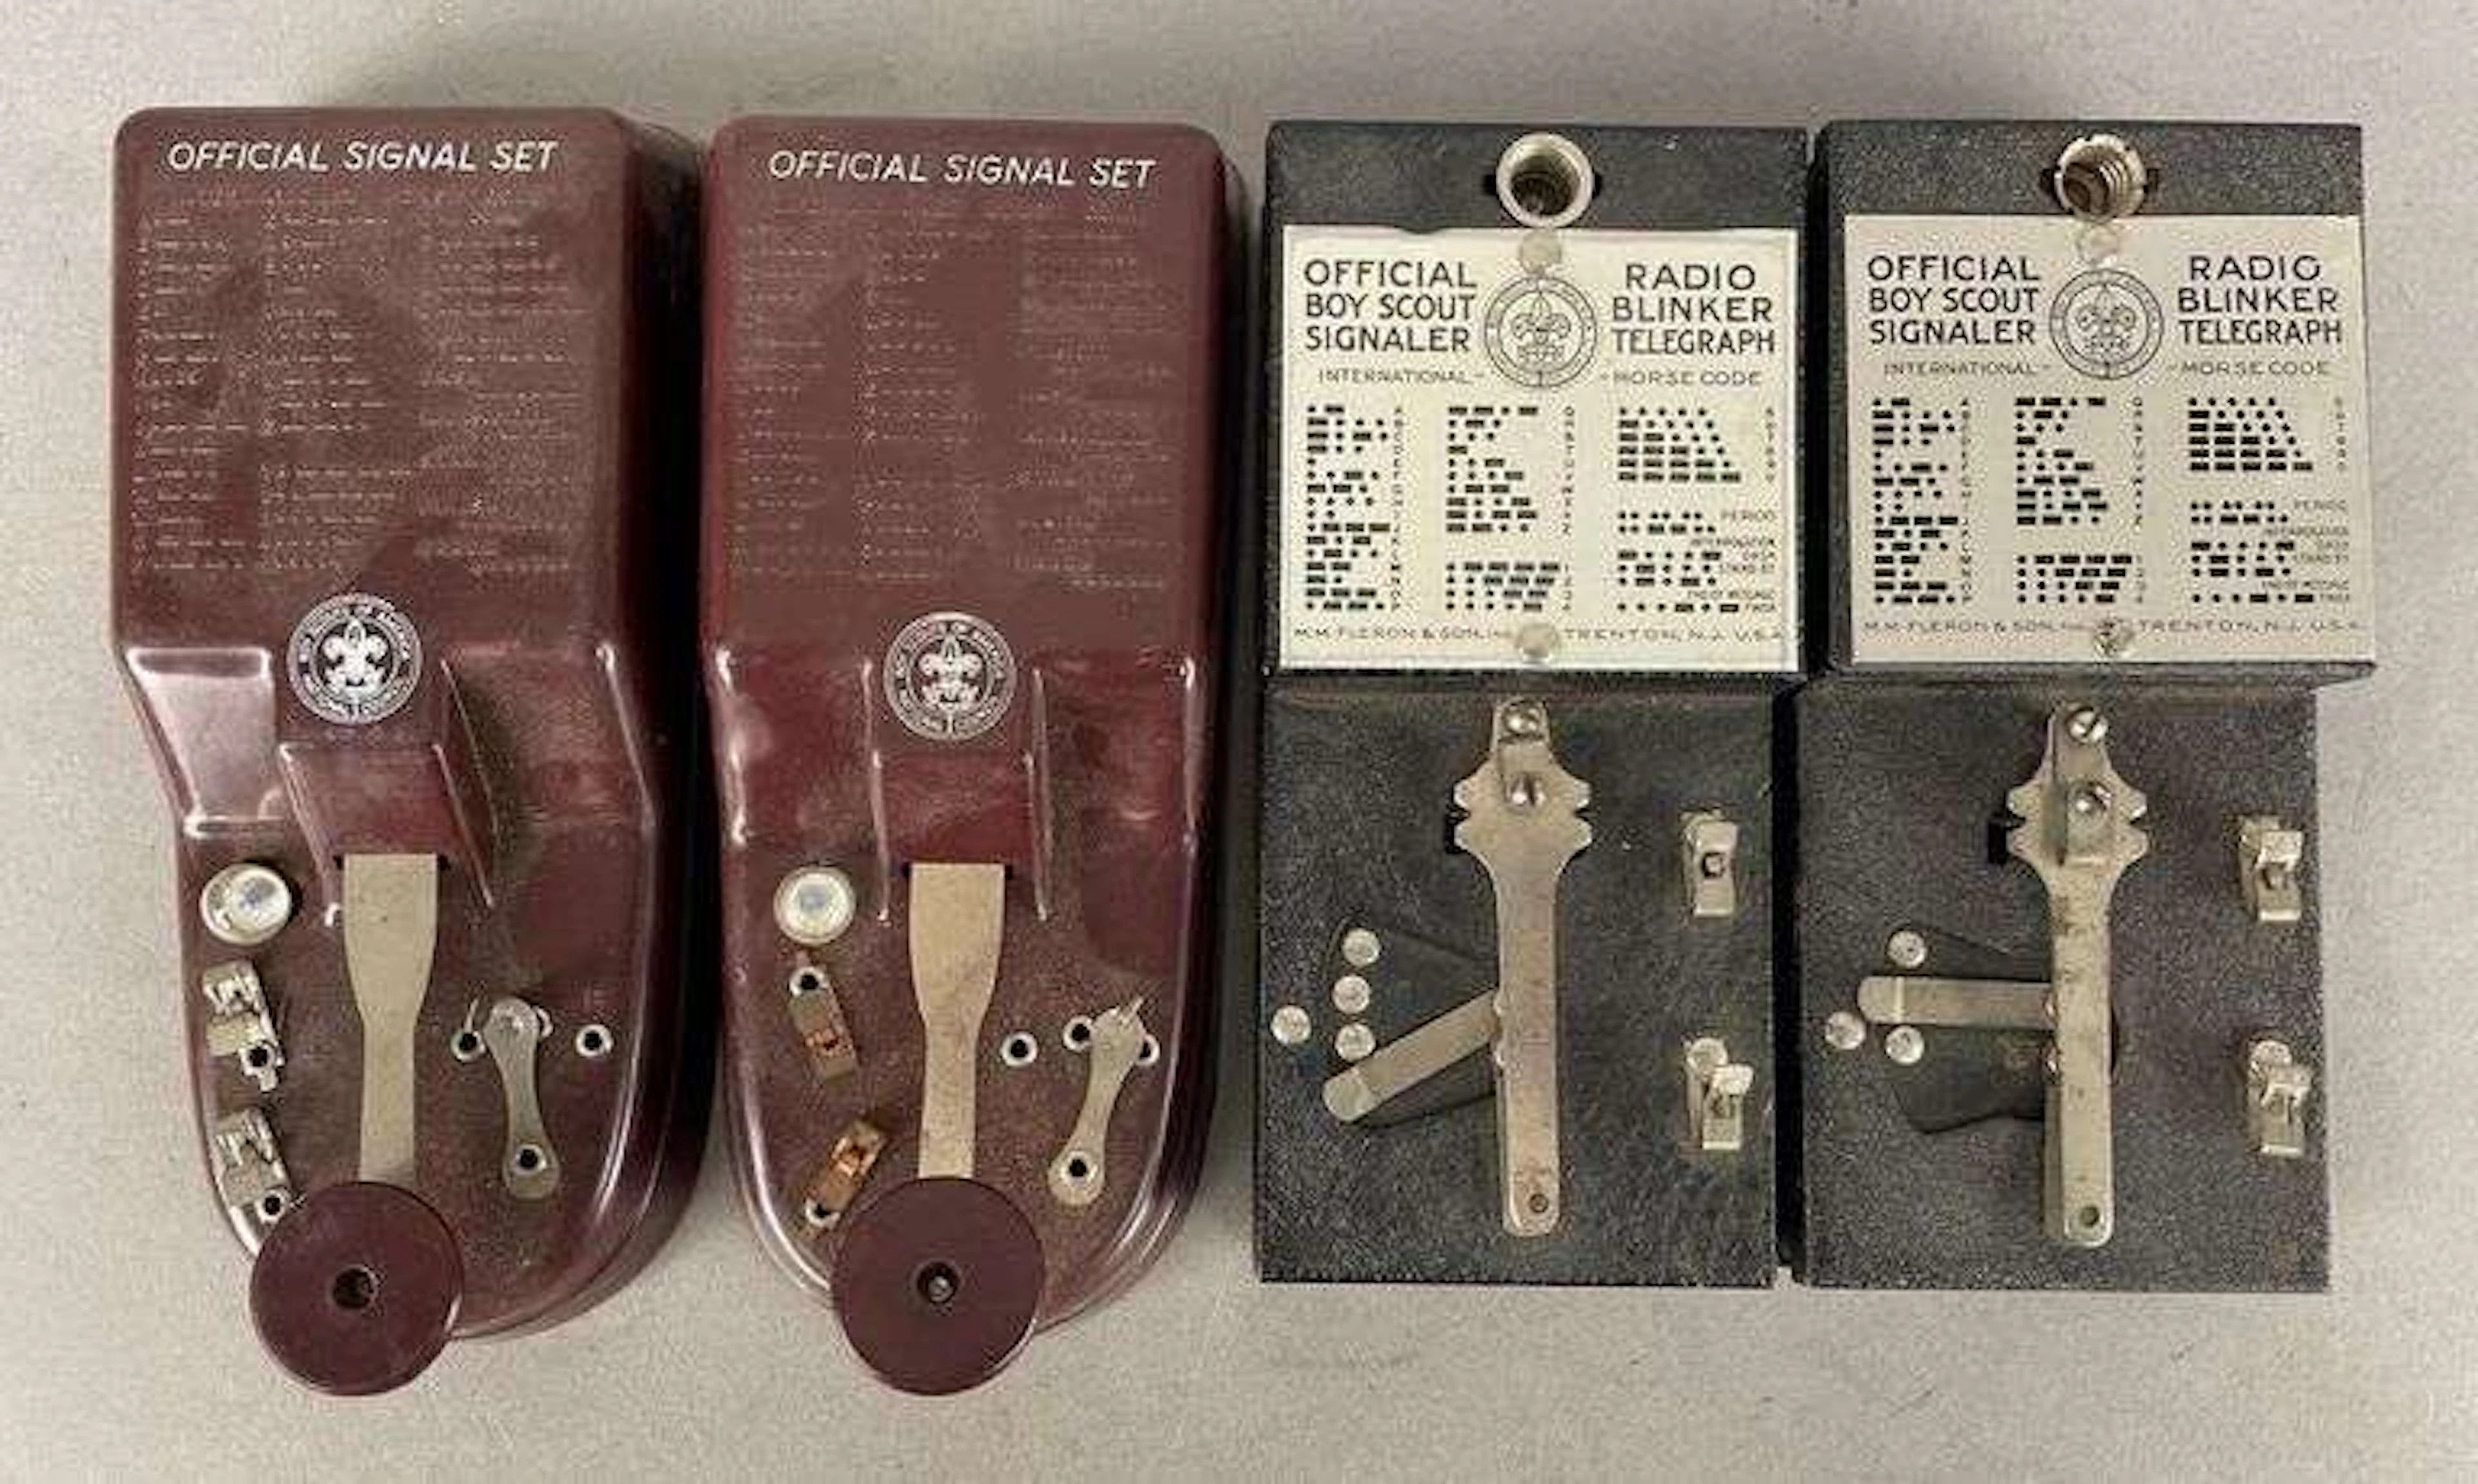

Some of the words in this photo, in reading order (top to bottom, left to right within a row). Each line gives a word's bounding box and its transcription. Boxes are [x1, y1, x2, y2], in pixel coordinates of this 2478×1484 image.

[168, 141, 328, 172] OFFICIAL
[343, 141, 476, 171] SIGNAL
[490, 141, 558, 172] SET
[769, 150, 927, 183] OFFICIAL
[944, 154, 1074, 186] SIGNAL
[1089, 158, 1156, 189] SET
[1303, 258, 1478, 289] OFFICIAL
[1626, 263, 1757, 292] RADIO
[1867, 254, 2041, 282] OFFICIAL
[2190, 254, 2321, 282] RADIO
[1305, 292, 1369, 319] BOY
[1378, 292, 1476, 321] SCOUT
[1613, 296, 1773, 323] BLINKER
[1869, 286, 1933, 314] BOY
[1942, 286, 2040, 314] SCOUT
[2177, 286, 2338, 314] BLINKER
[1305, 325, 1470, 353] SIGNALER
[1611, 328, 1775, 356] TELEGRAPH
[1869, 319, 2035, 345] SIGNALER
[2178, 319, 2342, 345] TELEGRAPH
[1613, 371, 1695, 385] MORSE
[1700, 370, 1762, 385] CODE
[2181, 361, 2265, 375] MORSE
